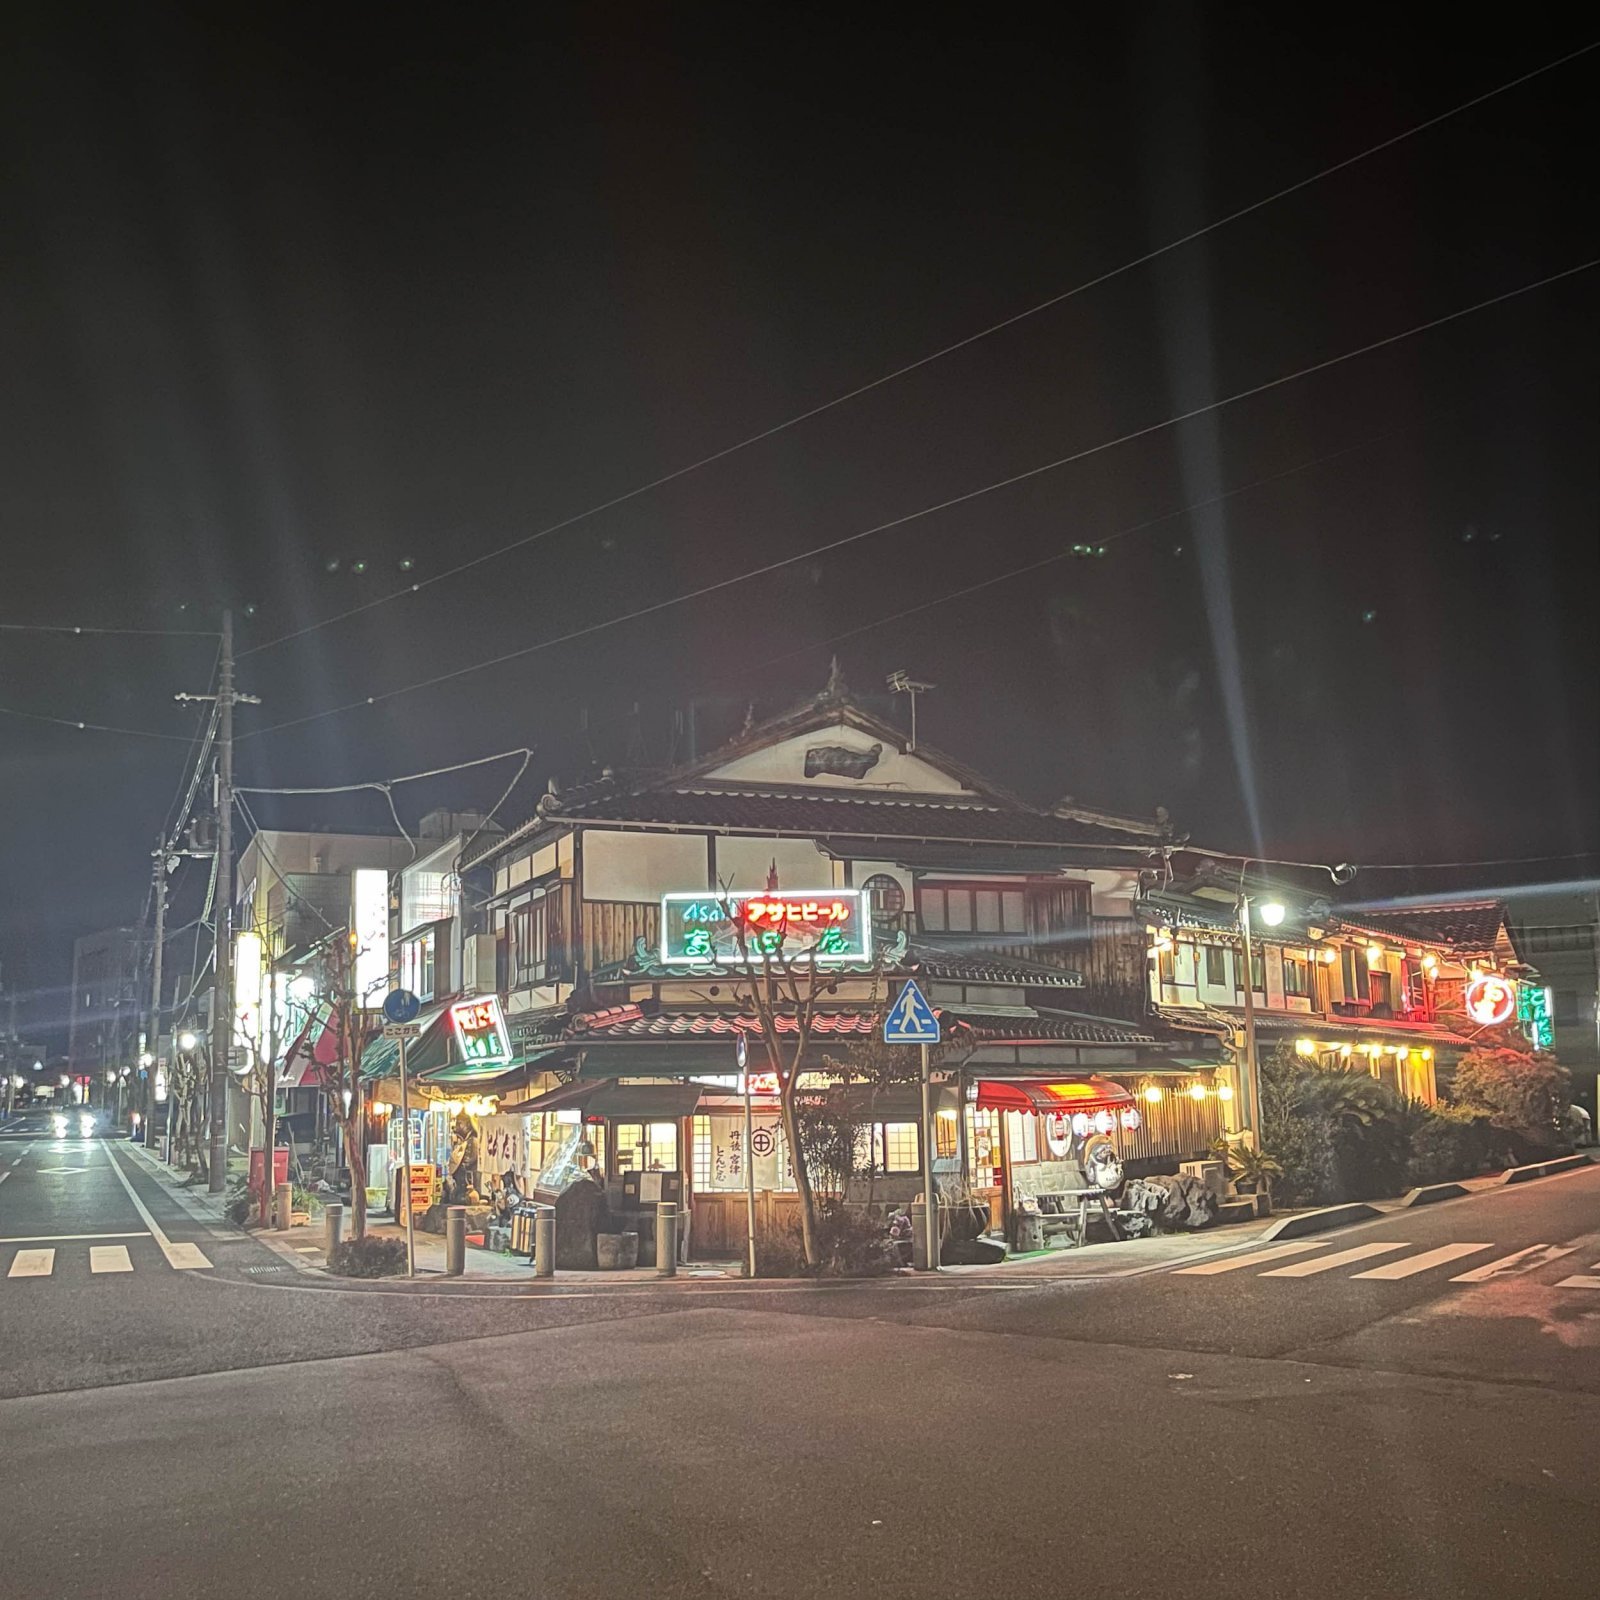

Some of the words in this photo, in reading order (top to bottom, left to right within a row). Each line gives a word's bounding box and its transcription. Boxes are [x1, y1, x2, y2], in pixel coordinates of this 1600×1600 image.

[747, 902, 849, 921] アサヒビール
[385, 1026, 420, 1036] ここから
